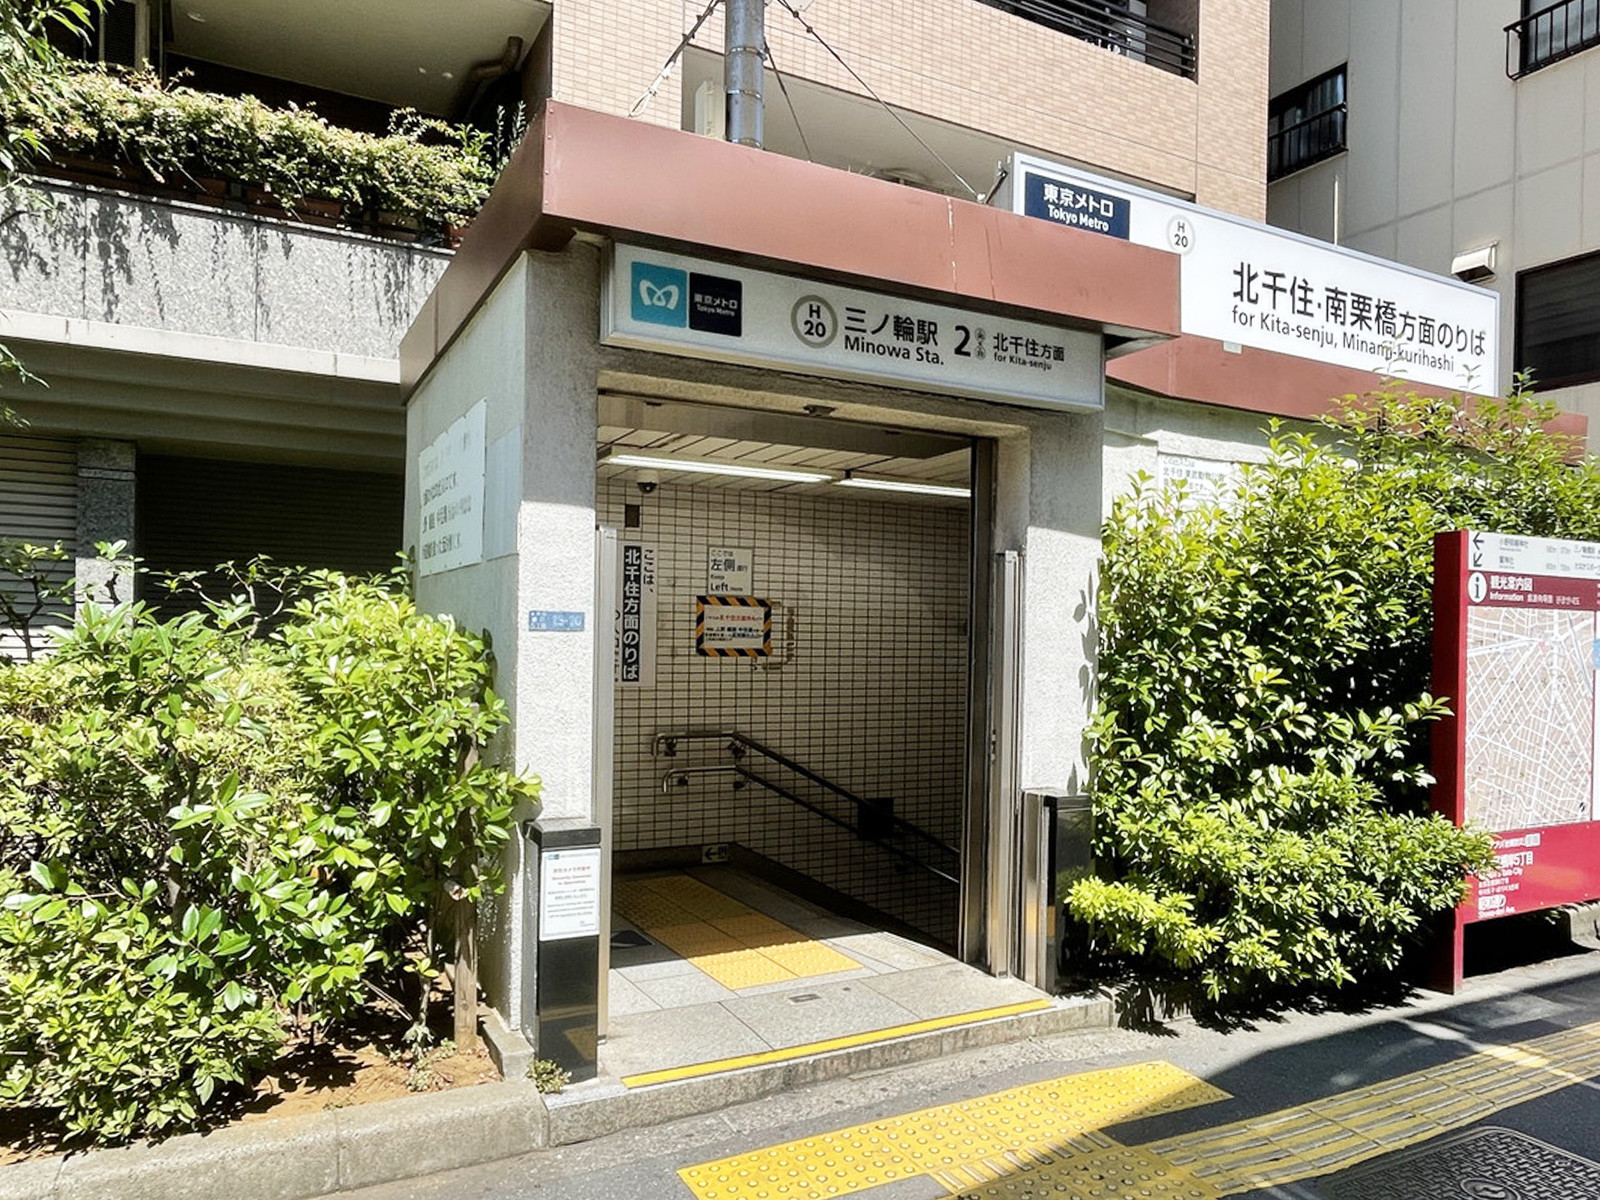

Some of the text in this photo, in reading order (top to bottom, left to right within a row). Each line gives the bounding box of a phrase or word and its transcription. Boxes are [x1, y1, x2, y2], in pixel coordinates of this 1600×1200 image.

[1043, 183, 1114, 218] 東京メトロ
[1048, 204, 1110, 232] Tokyo Metro
[1177, 221, 1186, 233] H
[1174, 234, 1189, 248] 20
[809, 304, 821, 319] H
[1233, 261, 1486, 356] 北千住・南栗橋方面のりば
[803, 320, 827, 338] 20
[844, 306, 939, 347] 三ノ輪駅
[953, 325, 972, 357] 2
[1232, 305, 1255, 328] for
[1260, 312, 1339, 349] Kita-senju,
[844, 335, 945, 366] Minowa Sta.
[993, 332, 1065, 362] 北千住方面
[994, 352, 1053, 372] for Kita-senju
[710, 581, 729, 592] Left
[623, 549, 641, 681] 北千住方面のりば
